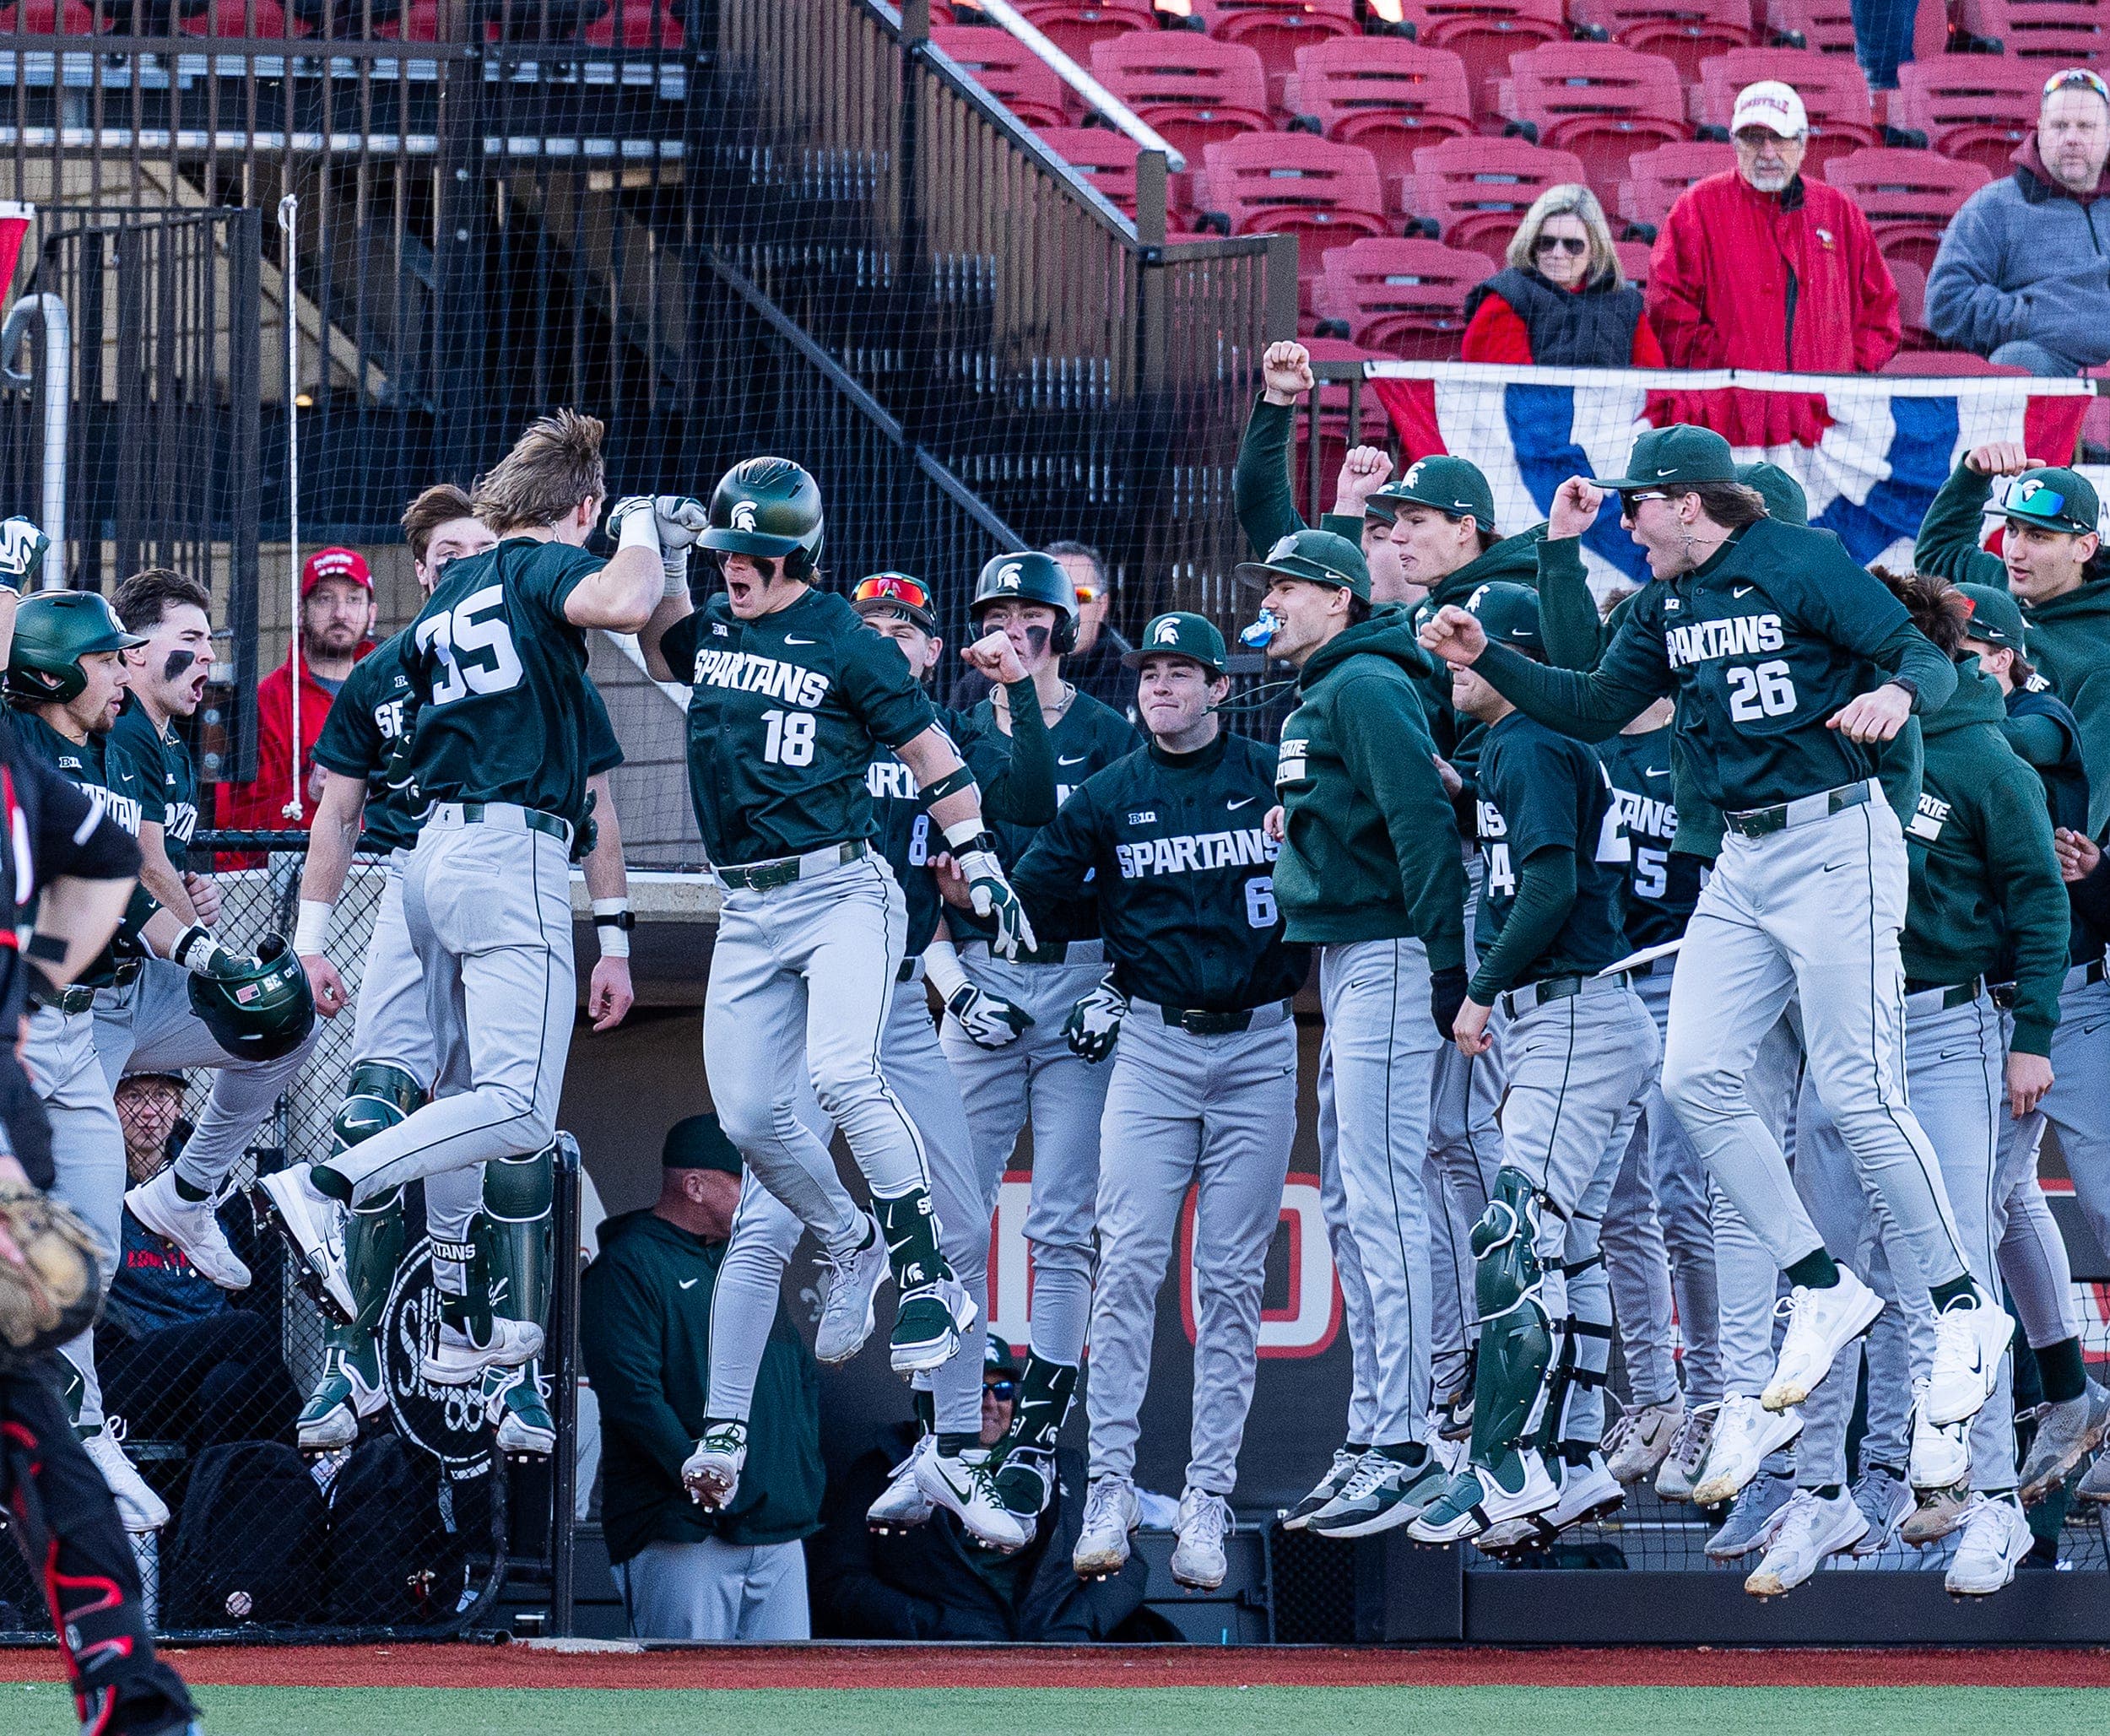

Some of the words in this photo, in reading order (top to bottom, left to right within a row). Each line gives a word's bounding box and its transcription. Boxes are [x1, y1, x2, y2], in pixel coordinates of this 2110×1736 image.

[414, 583, 523, 706] 35
[693, 648, 830, 709] SPARTANS
[1726, 659, 1798, 722] 26
[760, 709, 816, 767] 18
[909, 814, 929, 866] 8
[1116, 828, 1281, 879] SPARTANS
[1244, 876, 1279, 928] 6
